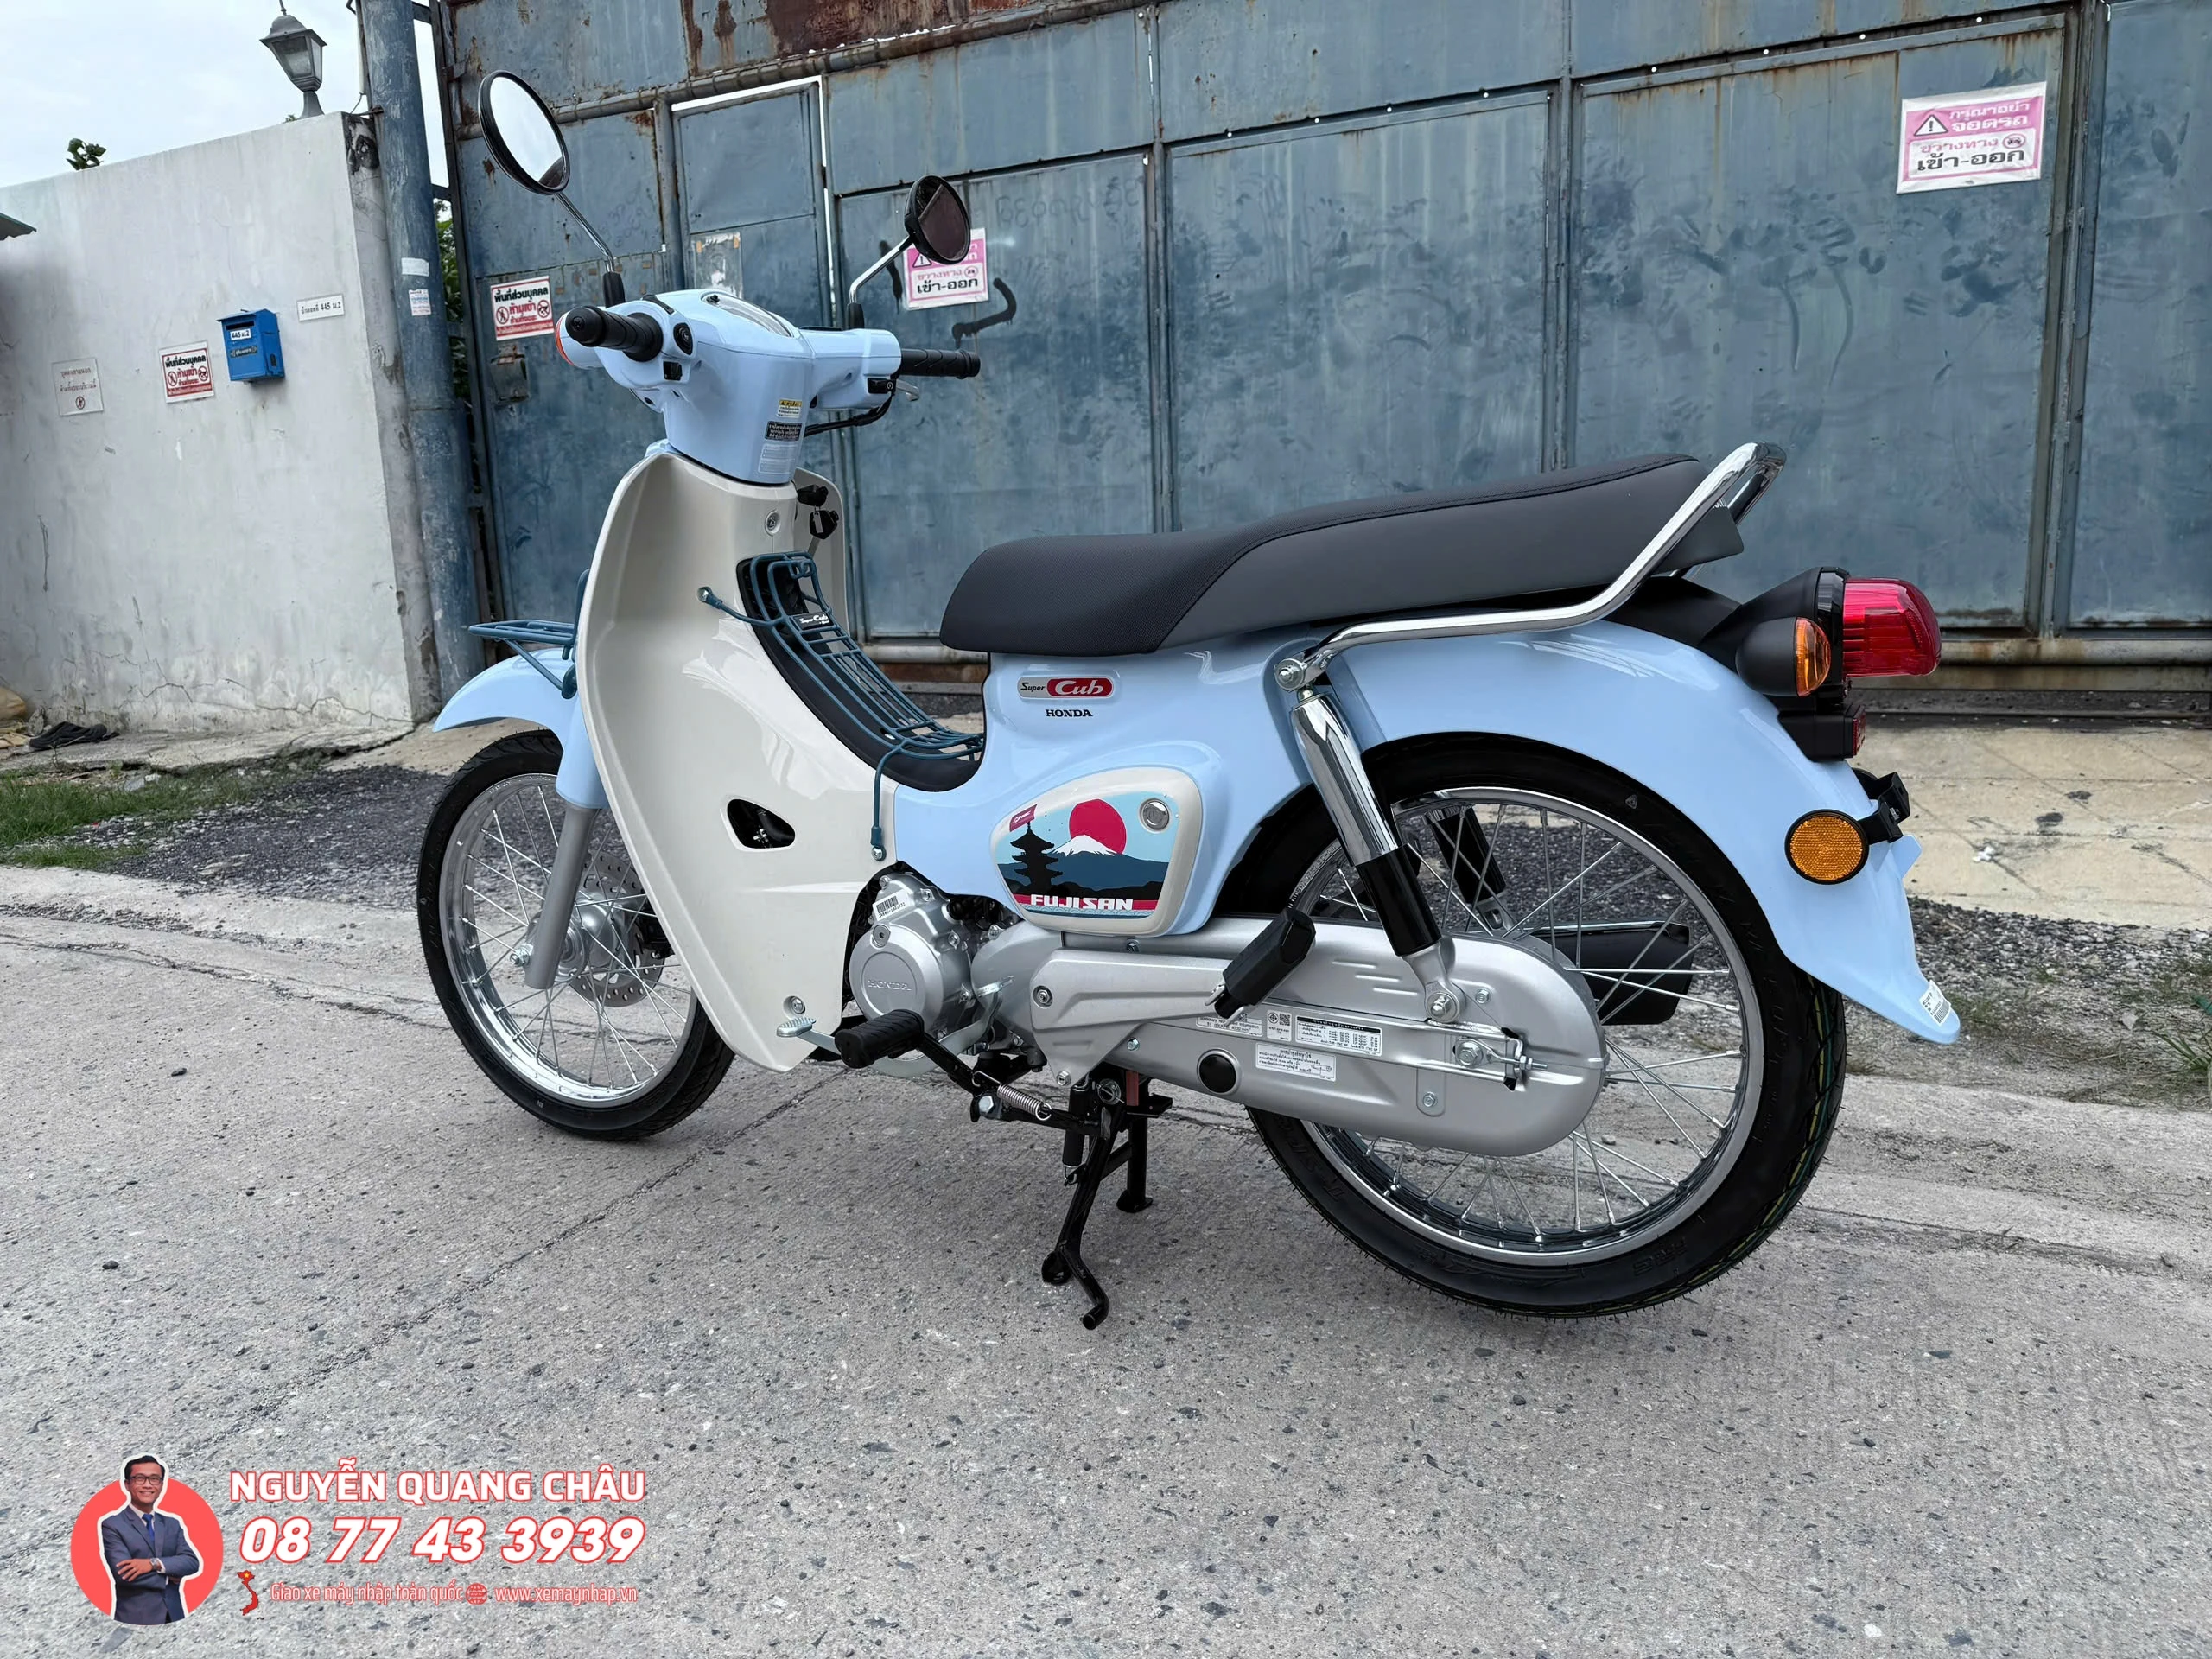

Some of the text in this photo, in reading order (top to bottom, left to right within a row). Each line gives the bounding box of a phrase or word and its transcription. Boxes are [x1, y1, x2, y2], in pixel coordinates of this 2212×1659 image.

[1949, 101, 2031, 121] กรุณาอย่า
[1951, 115, 2029, 132] จอดรถ
[1920, 137, 1999, 155] ขวางทาง
[1916, 149, 2025, 172] เข้า-ออก
[916, 269, 963, 281] ขวางทาง
[917, 277, 979, 295] เข้า-ออก
[493, 287, 549, 302] พื้นที่ส่วนบุคคล
[321, 302, 331, 311] 445
[509, 300, 537, 315] ห้ามเข้า
[165, 354, 207, 368] พื้นที่ส่วนบุคคล
[1020, 679, 1104, 696] Super Cub
[1045, 709, 1094, 717] HONDA
[1030, 893, 1134, 911] FUJISAN
[867, 979, 912, 991] HONDA
